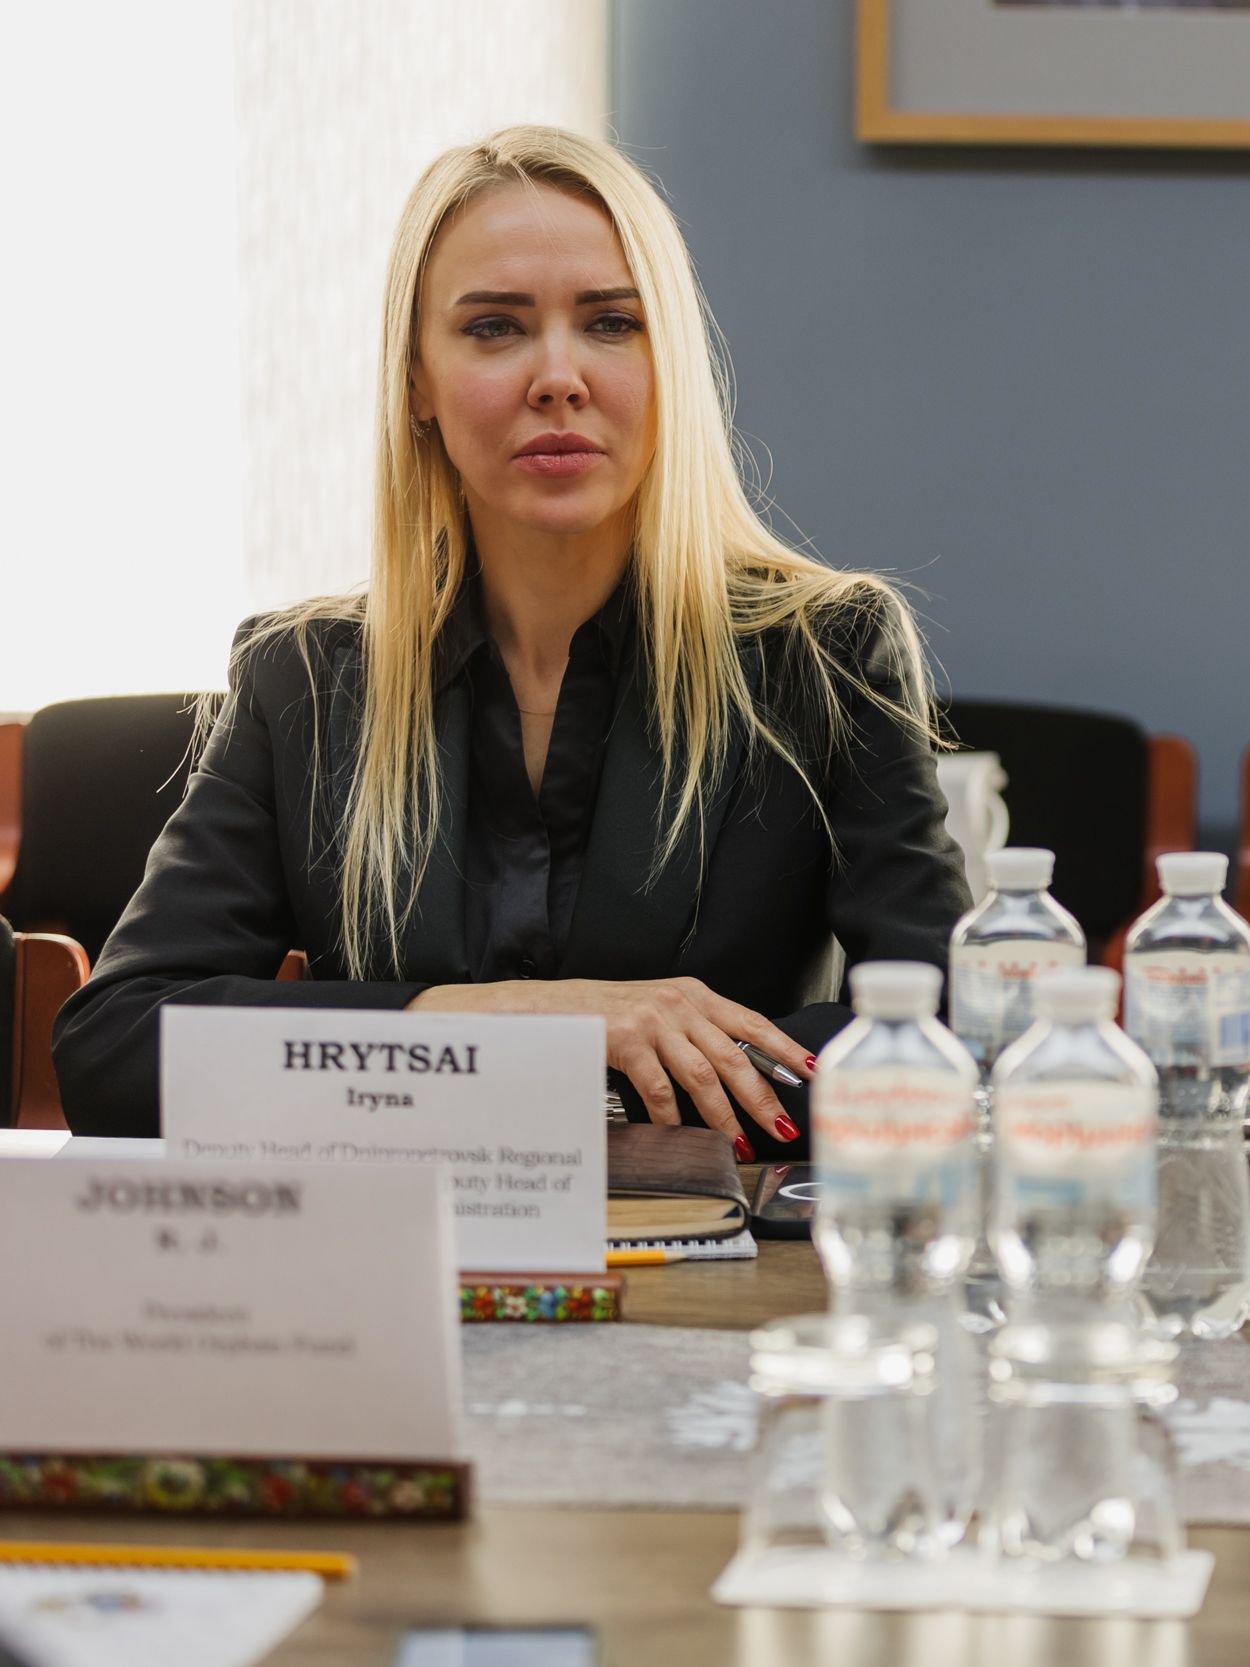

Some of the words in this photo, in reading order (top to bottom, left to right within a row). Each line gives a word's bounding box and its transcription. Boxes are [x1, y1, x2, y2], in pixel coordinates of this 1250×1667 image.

[282, 1040, 480, 1075] HRYTSAI
[346, 1087, 414, 1112] Iryna
[498, 1146, 583, 1171] Regional
[496, 1172, 547, 1192] Head
[553, 1173, 574, 1193] of
[77, 1175, 303, 1219] JOHNSON
